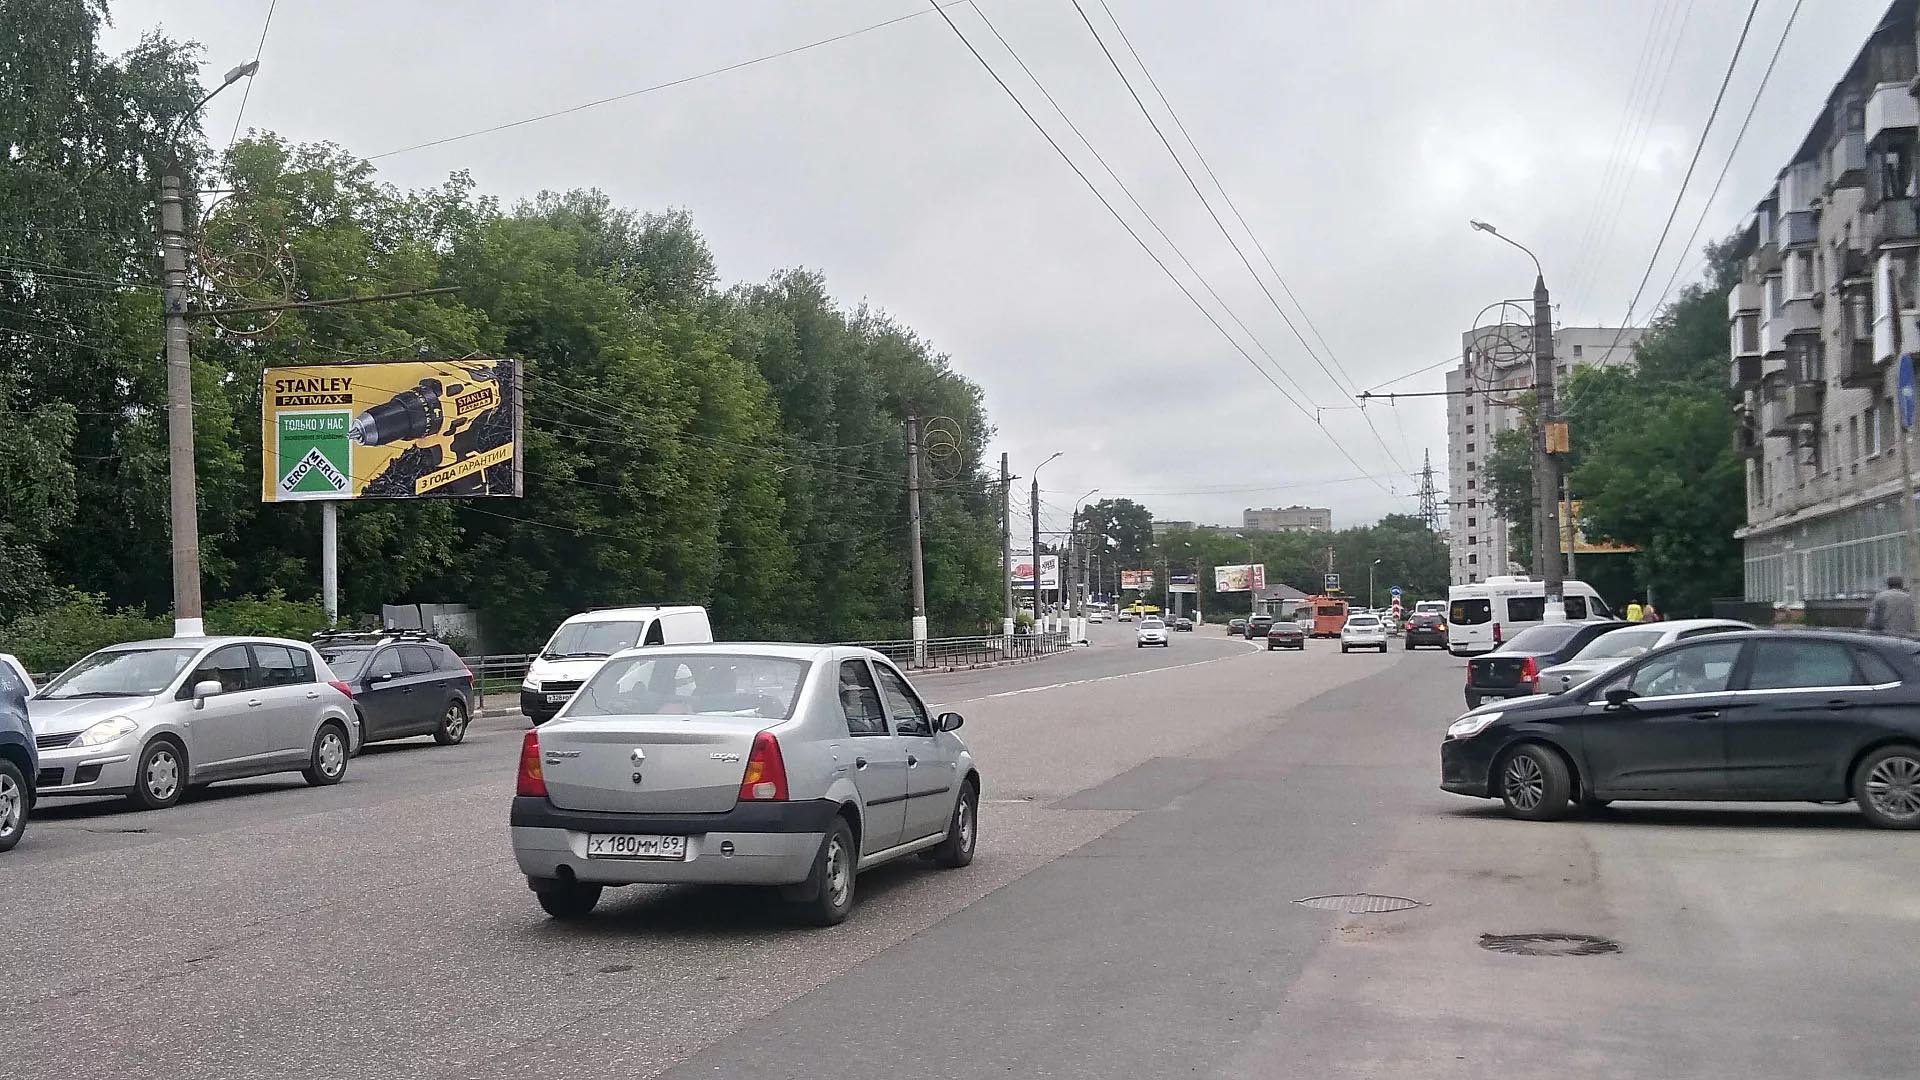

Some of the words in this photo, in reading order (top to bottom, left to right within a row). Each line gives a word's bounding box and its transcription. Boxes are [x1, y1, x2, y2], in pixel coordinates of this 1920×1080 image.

[276, 377, 352, 393] STANLEY
[282, 395, 344, 405] FATMAX
[457, 389, 490, 407] STANLEY
[284, 419, 317, 431] ТОЛЬКО
[320, 418, 325, 430] У
[327, 418, 344, 430] НАС
[282, 458, 313, 491] LEROY
[309, 450, 346, 490] MERLIN
[421, 479, 427, 489] 3
[430, 469, 456, 485] ГОДА
[458, 448, 507, 475] ГАРАНТИИ
